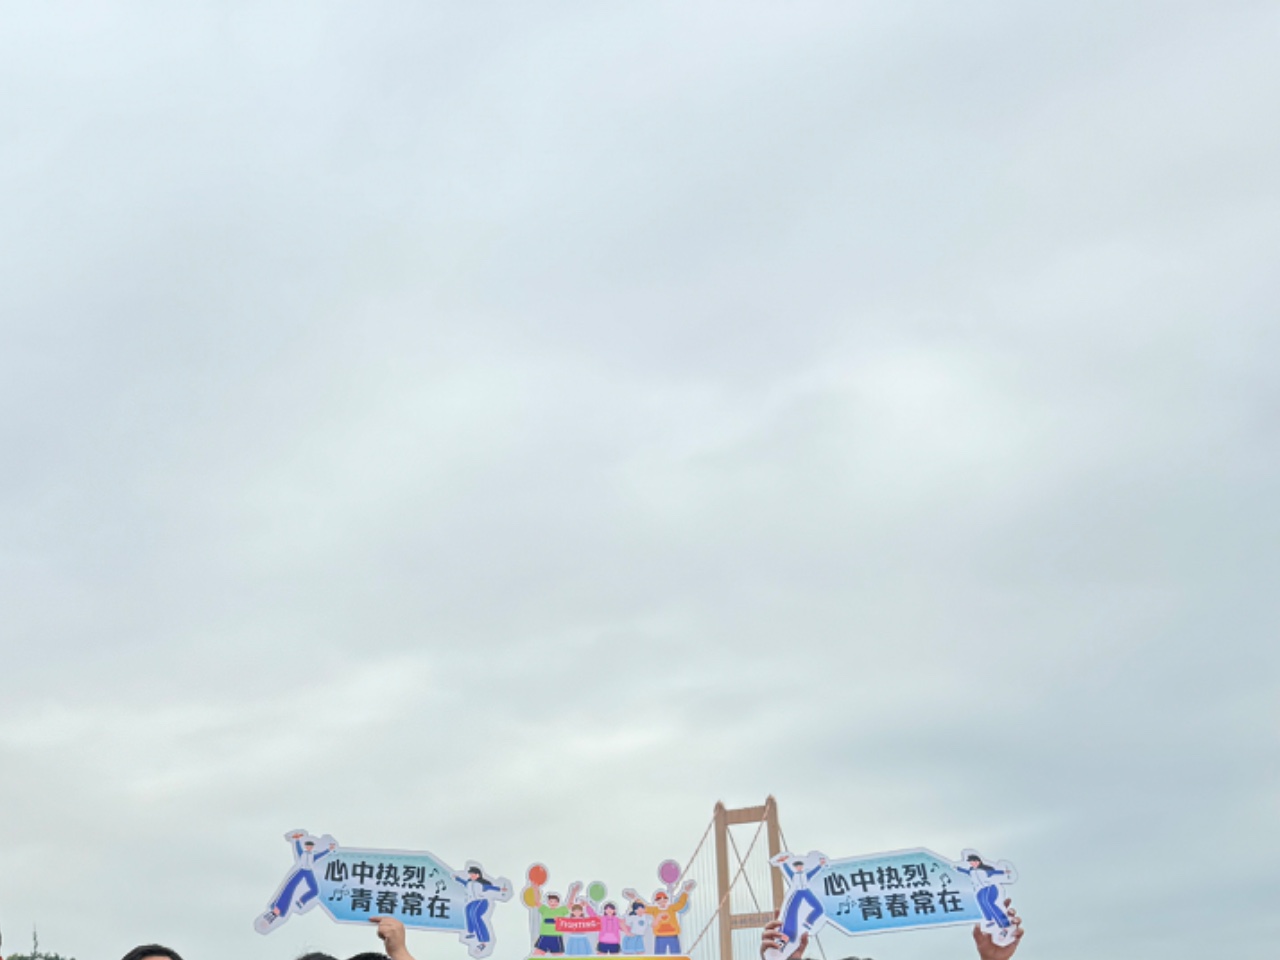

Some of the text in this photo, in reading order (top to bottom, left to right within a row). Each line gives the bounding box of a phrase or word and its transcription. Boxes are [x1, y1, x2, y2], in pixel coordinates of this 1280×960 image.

[324, 859, 427, 889] 心中热烈
[823, 862, 931, 896] 心中热烈
[350, 887, 451, 919] 青春常在
[857, 889, 964, 921] 青春常在
